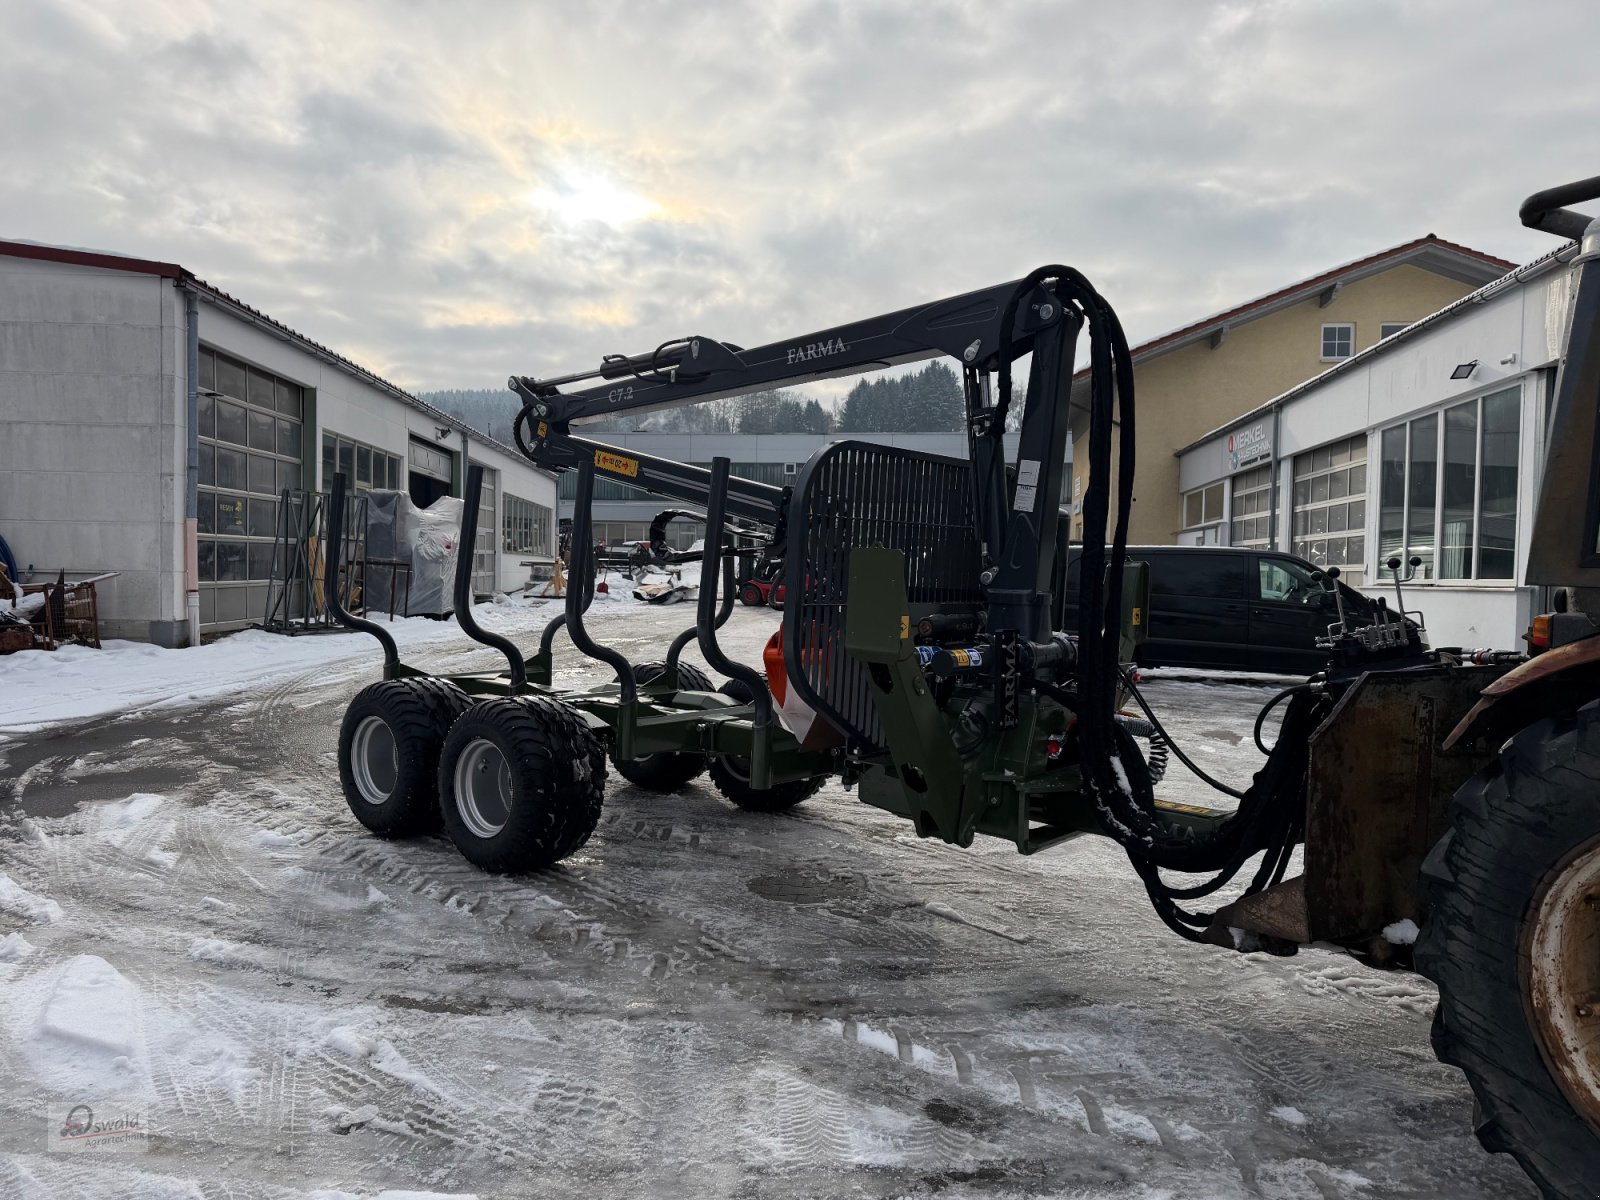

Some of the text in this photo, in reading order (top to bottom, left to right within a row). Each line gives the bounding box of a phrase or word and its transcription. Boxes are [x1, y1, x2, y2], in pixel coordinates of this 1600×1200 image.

[786, 337, 847, 365] FARMA
[608, 386, 634, 403] C7.2
[1233, 423, 1266, 452] MERKEL
[1004, 633, 1017, 728] FARMA
